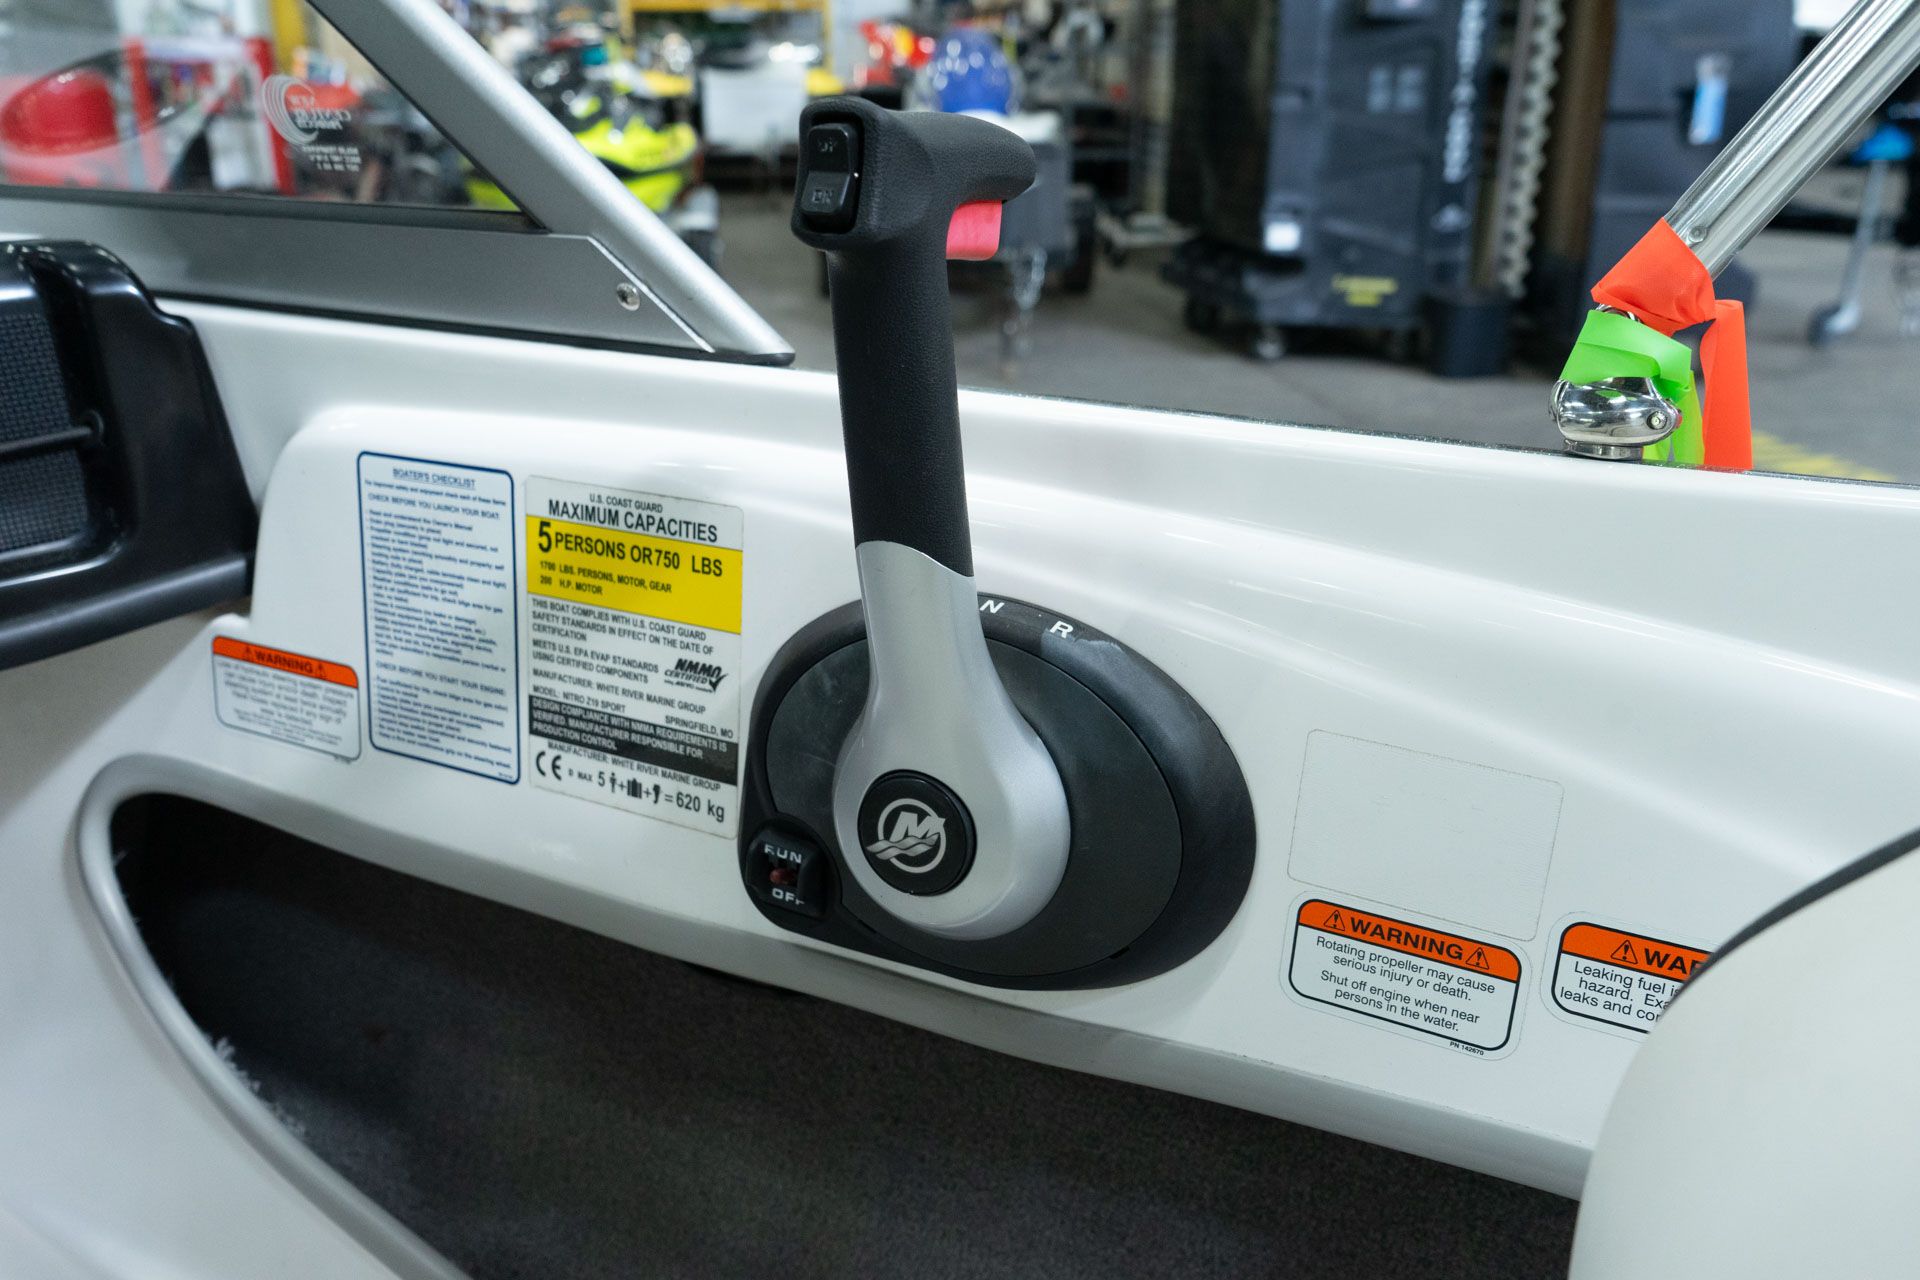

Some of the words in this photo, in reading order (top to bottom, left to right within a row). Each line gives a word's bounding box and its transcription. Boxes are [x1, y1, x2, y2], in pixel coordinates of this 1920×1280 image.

[432, 473, 476, 489] CHECKLIST
[589, 493, 604, 504] U.S.
[606, 495, 632, 510] COAST
[635, 499, 664, 514] GUARD
[548, 499, 620, 527] MAXIMUM
[624, 511, 719, 543] CAPACITIES
[538, 519, 553, 553] 5
[554, 531, 626, 560] PERSONS
[630, 544, 653, 565] OR
[655, 549, 681, 570] 750
[691, 555, 724, 578] LBS
[575, 581, 603, 596] MOTOR
[649, 580, 673, 593] GEAR
[532, 598, 548, 609] THIS
[550, 602, 570, 613] BOAT
[571, 606, 610, 622] COMPLIES
[611, 613, 631, 625] WITH
[649, 621, 676, 635] COAST
[677, 627, 706, 641] GUARD
[980, 599, 1006, 614] N
[532, 610, 560, 624] SAFETY
[561, 616, 607, 634] STANDARDS
[608, 625, 616, 635] IN
[617, 628, 647, 641] EFFECT
[649, 634, 661, 645] ON
[662, 636, 678, 648] THE
[679, 640, 701, 653] DATE
[702, 645, 715, 655] OF
[532, 623, 588, 642] CERTIFICATION
[1049, 620, 1074, 639] R
[254, 650, 314, 673] WARNING
[532, 639, 557, 651] MEETS
[573, 646, 589, 658] EPA
[612, 655, 659, 674] STANDARDS
[532, 650, 555, 664] USING
[556, 655, 595, 672] CERTIFIED
[595, 664, 649, 684] COMPONENTS
[562, 691, 585, 705] NITRO
[600, 700, 626, 713] SPORT
[596, 682, 620, 696] WHITE
[621, 687, 644, 701] RIVER
[646, 693, 676, 708] MARINE
[677, 700, 707, 715] GROUP
[561, 703, 610, 723] COMPLIANCE
[655, 725, 718, 751] REQUIREMENTS
[718, 741, 728, 753] IS
[720, 727, 734, 739] MO
[630, 732, 685, 756] RESPONSIBLE
[686, 746, 704, 760] FOR
[535, 750, 562, 781] CE
[597, 770, 606, 787] 5
[706, 798, 726, 823] kg
[611, 757, 635, 771] WHITE
[636, 761, 659, 775] RIVER
[660, 769, 690, 785] MARINE
[692, 776, 722, 792] GROUP
[1349, 916, 1464, 961] WARNING
[1315, 935, 1366, 960] Rotating
[1368, 951, 1425, 975] propeller
[1426, 966, 1454, 985] may
[1457, 975, 1497, 995] cause
[1332, 955, 1377, 975] serious
[1379, 965, 1414, 988] injury
[1416, 977, 1430, 988] or
[1432, 979, 1473, 1002] death.
[1574, 961, 1634, 989] Leaking
[1638, 976, 1667, 995] fuel
[1320, 969, 1350, 987] Shut
[1350, 978, 1369, 993] off
[1369, 985, 1411, 1006] engine
[1414, 997, 1454, 1016] when
[1451, 1007, 1481, 1025] near
[1560, 986, 1600, 1008] leaks
[1602, 998, 1633, 1017] and
[1578, 976, 1635, 1002] hazard.
[1334, 988, 1383, 1011] persons
[1386, 1000, 1399, 1014] in
[1400, 1004, 1420, 1021] the
[1423, 1014, 1460, 1033] water.
[1449, 1039, 1461, 1050] PN
